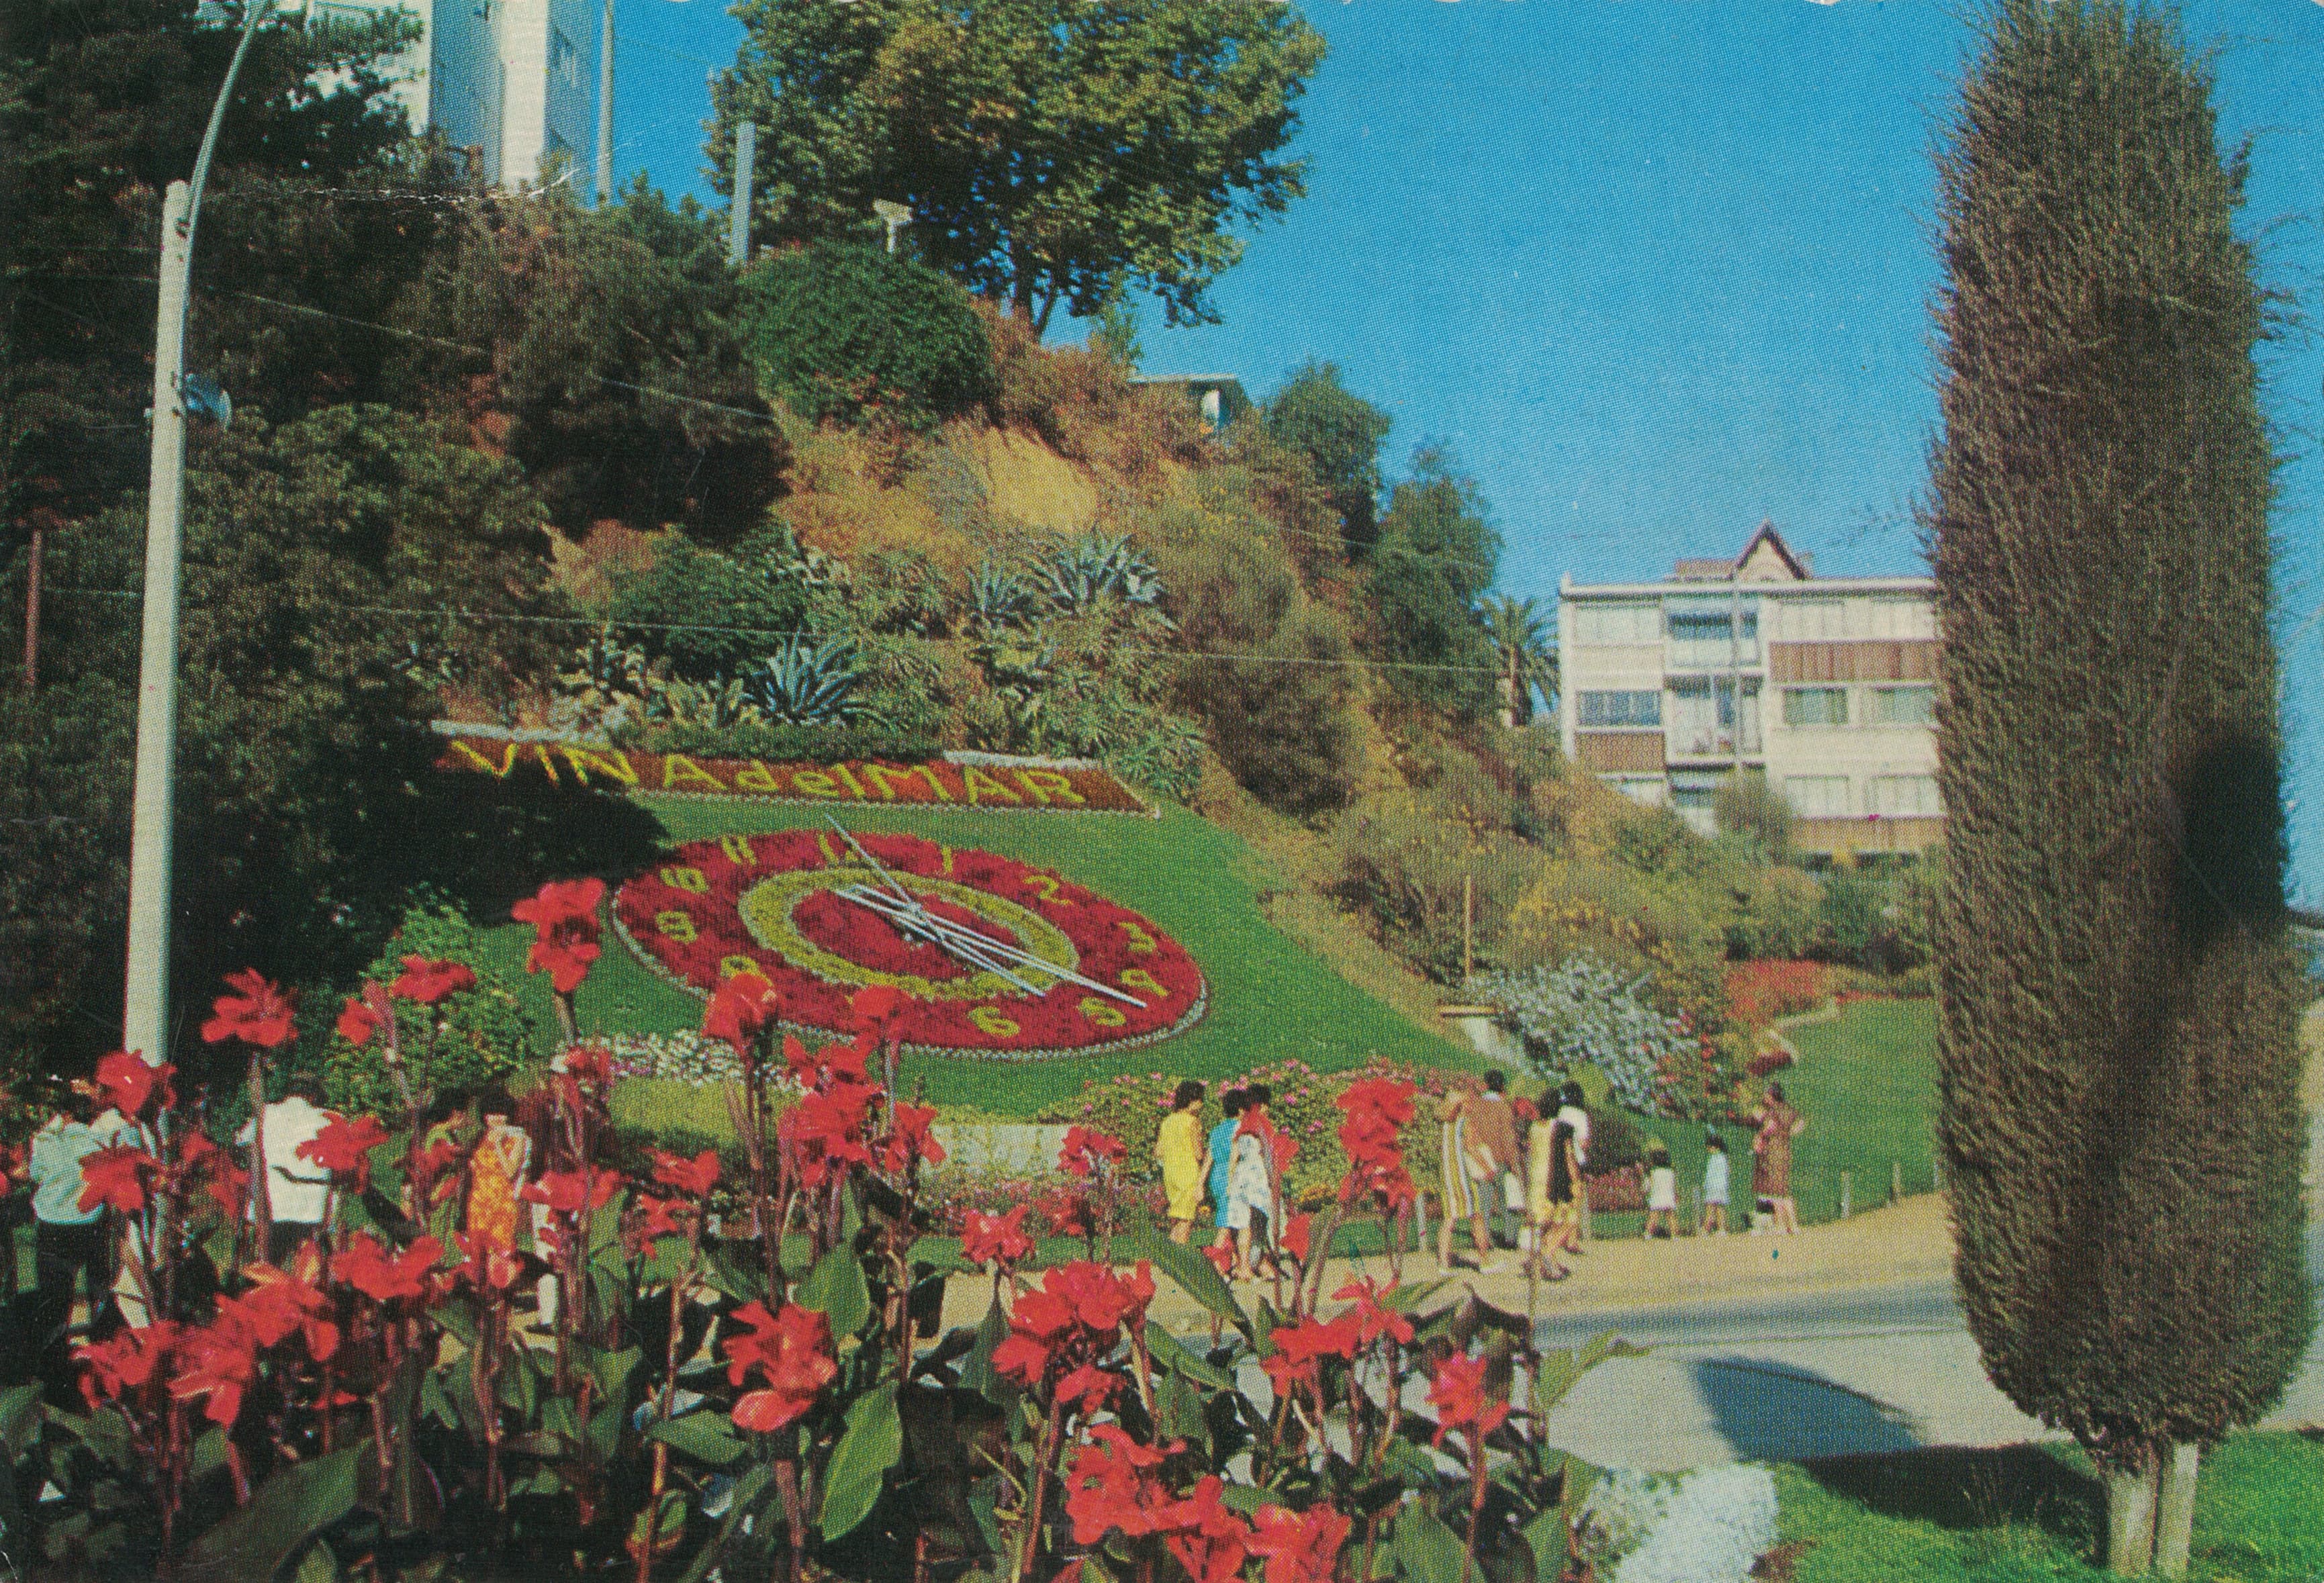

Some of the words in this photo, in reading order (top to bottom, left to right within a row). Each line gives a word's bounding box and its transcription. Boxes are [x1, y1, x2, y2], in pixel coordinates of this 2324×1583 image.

[722, 836, 757, 865] 11
[941, 846, 954, 873] 1
[1023, 875, 1074, 906] 2
[655, 911, 698, 944] 9
[1119, 922, 1157, 954] 3
[1119, 968, 1170, 998] 4
[967, 1006, 1021, 1038] 6
[1077, 996, 1127, 1028] 5
